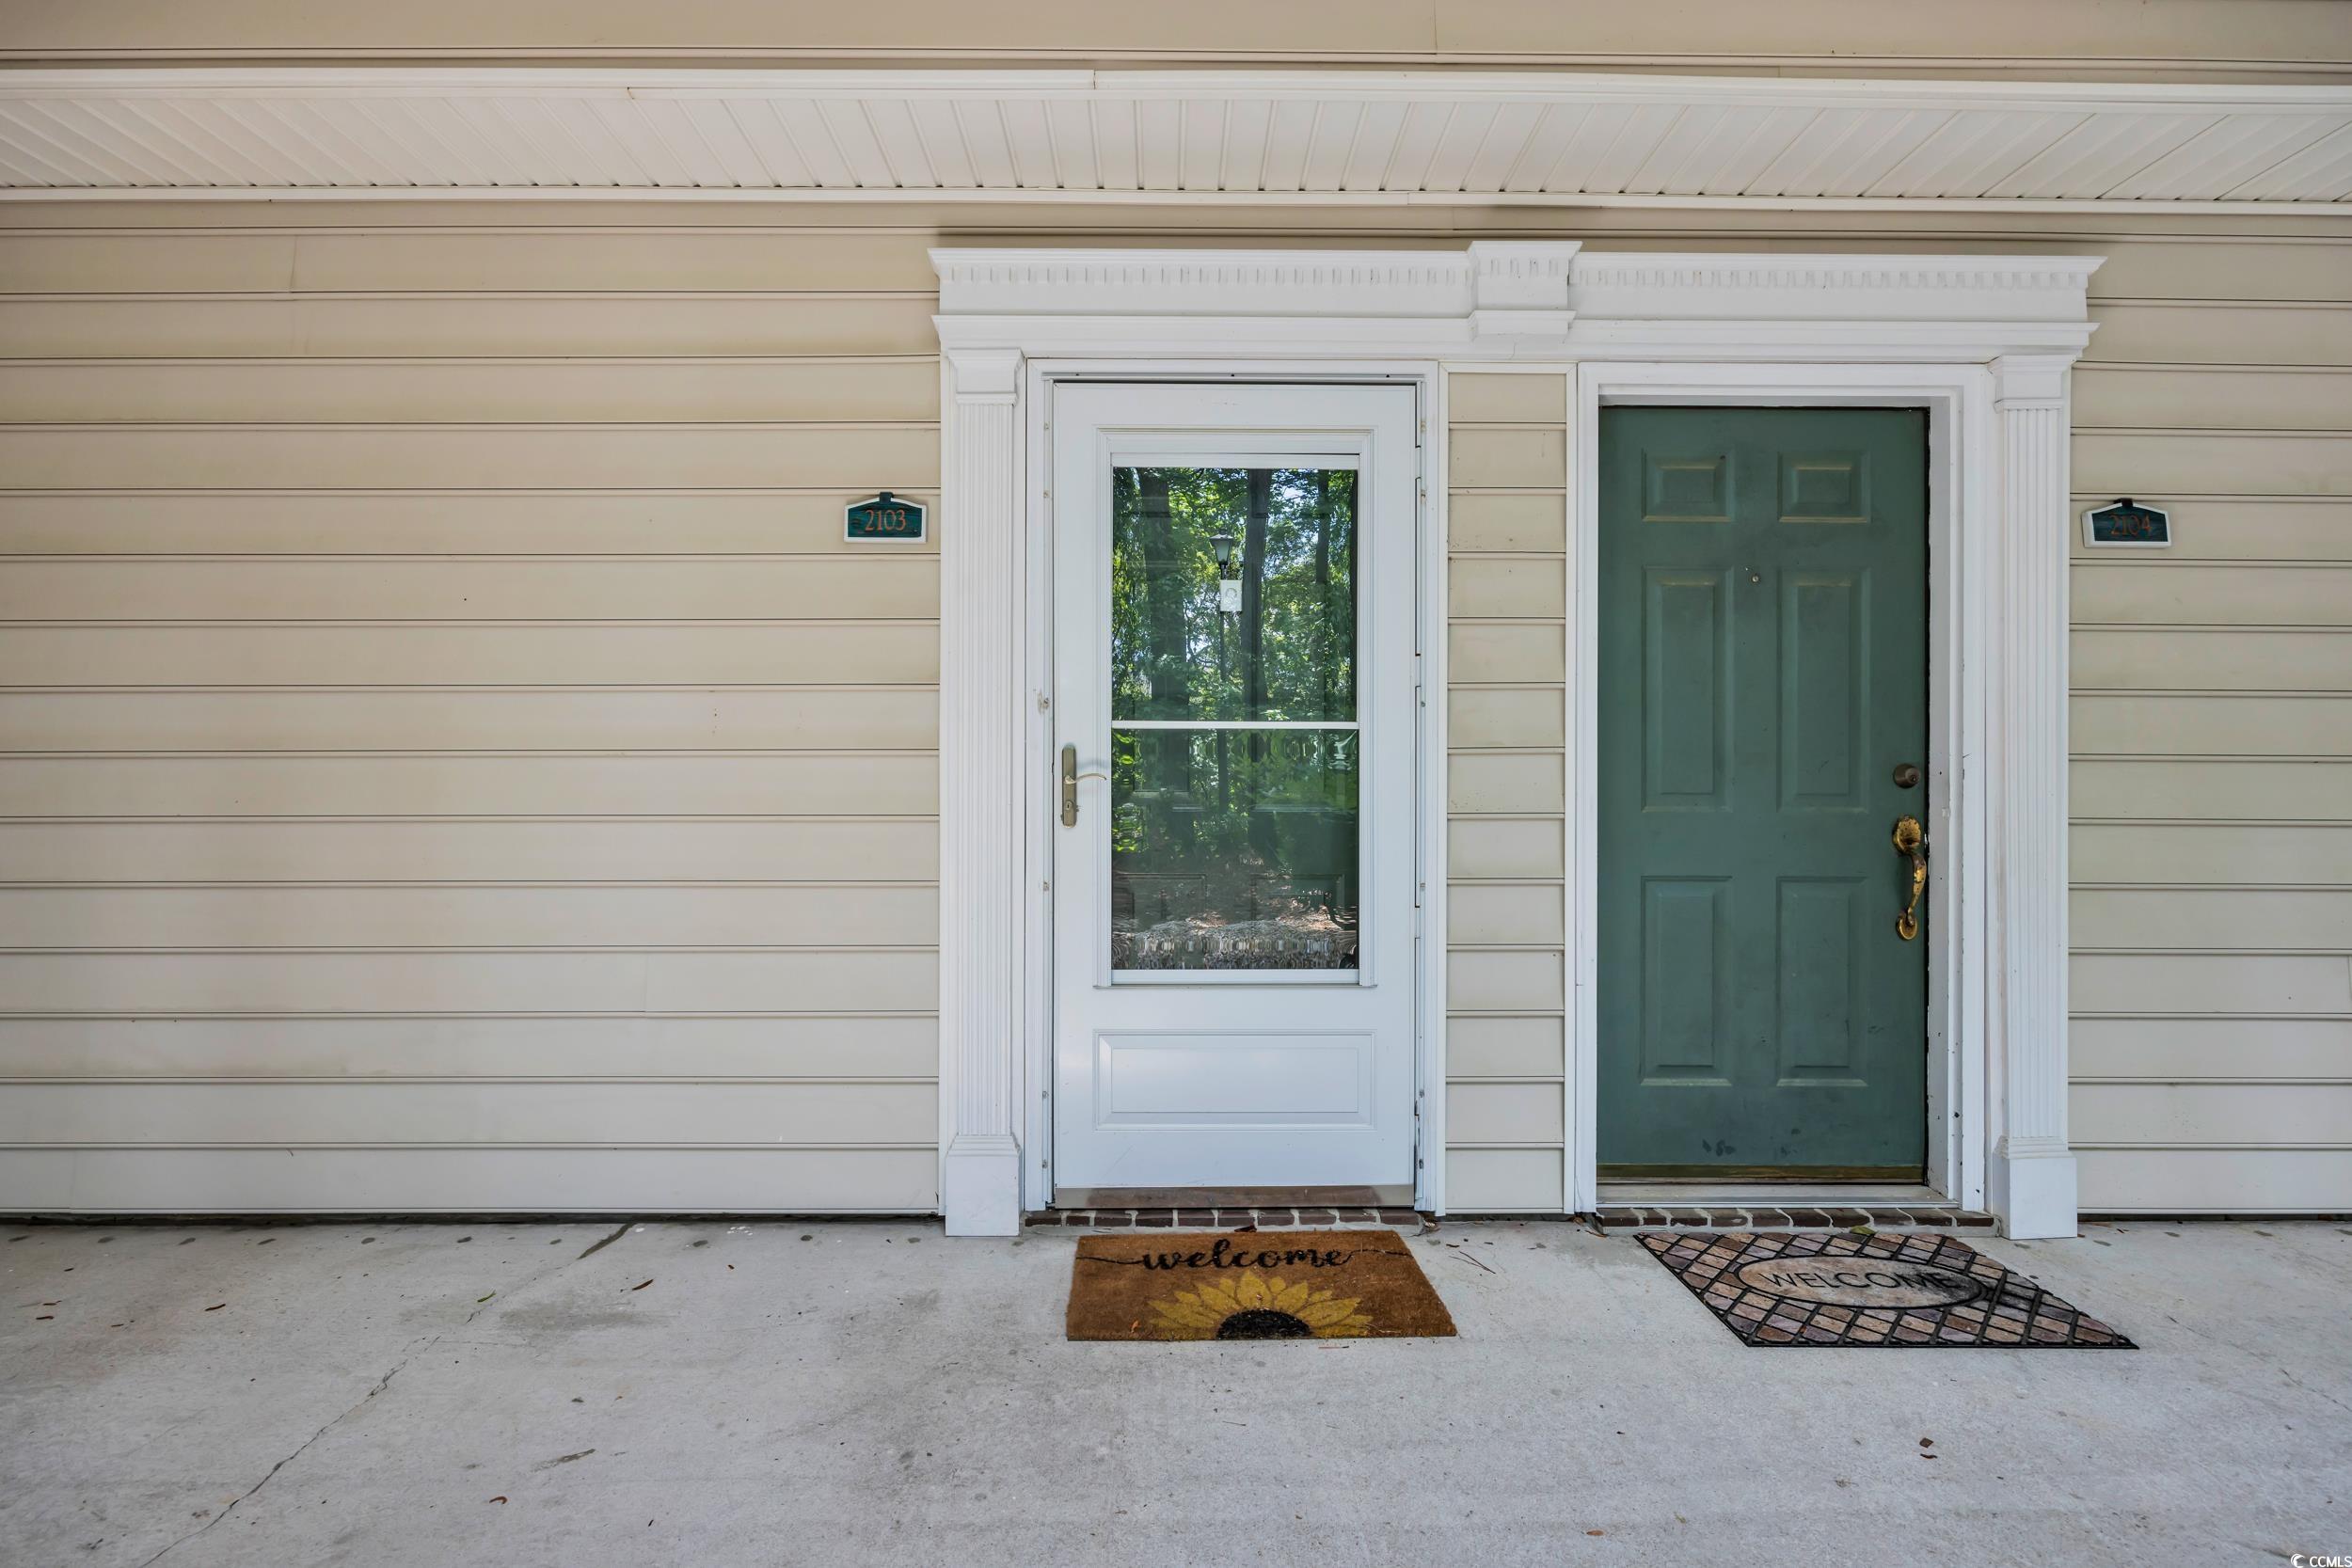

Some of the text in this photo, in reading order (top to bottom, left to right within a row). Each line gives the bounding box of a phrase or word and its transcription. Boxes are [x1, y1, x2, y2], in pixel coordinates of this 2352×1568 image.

[865, 509, 906, 531] 2103
[1141, 1238, 1355, 1271] welcome
[1758, 1271, 1964, 1290] WELCOME
